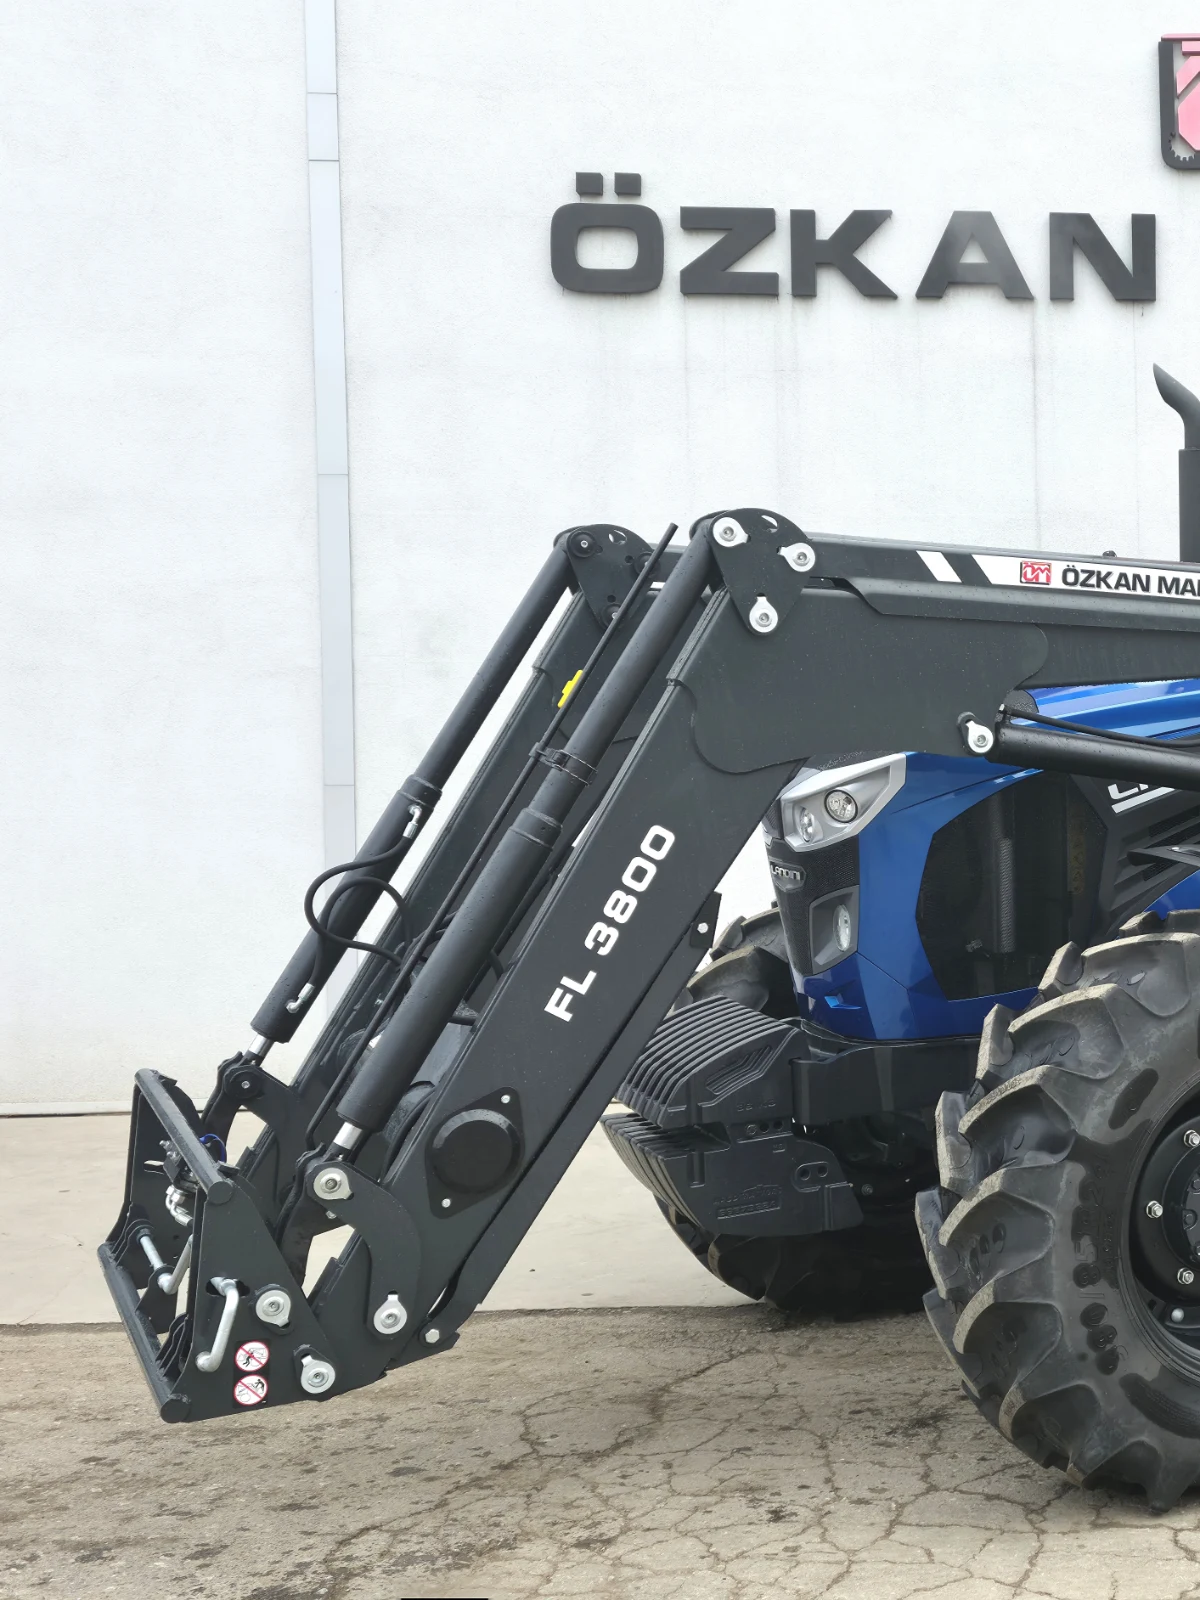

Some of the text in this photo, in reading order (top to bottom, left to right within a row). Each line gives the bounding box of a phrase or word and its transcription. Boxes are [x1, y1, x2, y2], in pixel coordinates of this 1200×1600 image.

[550, 171, 1157, 302] ÖZKAN
[1061, 565, 1151, 592] ÖZKAN
[544, 824, 676, 1022] FL 3800
